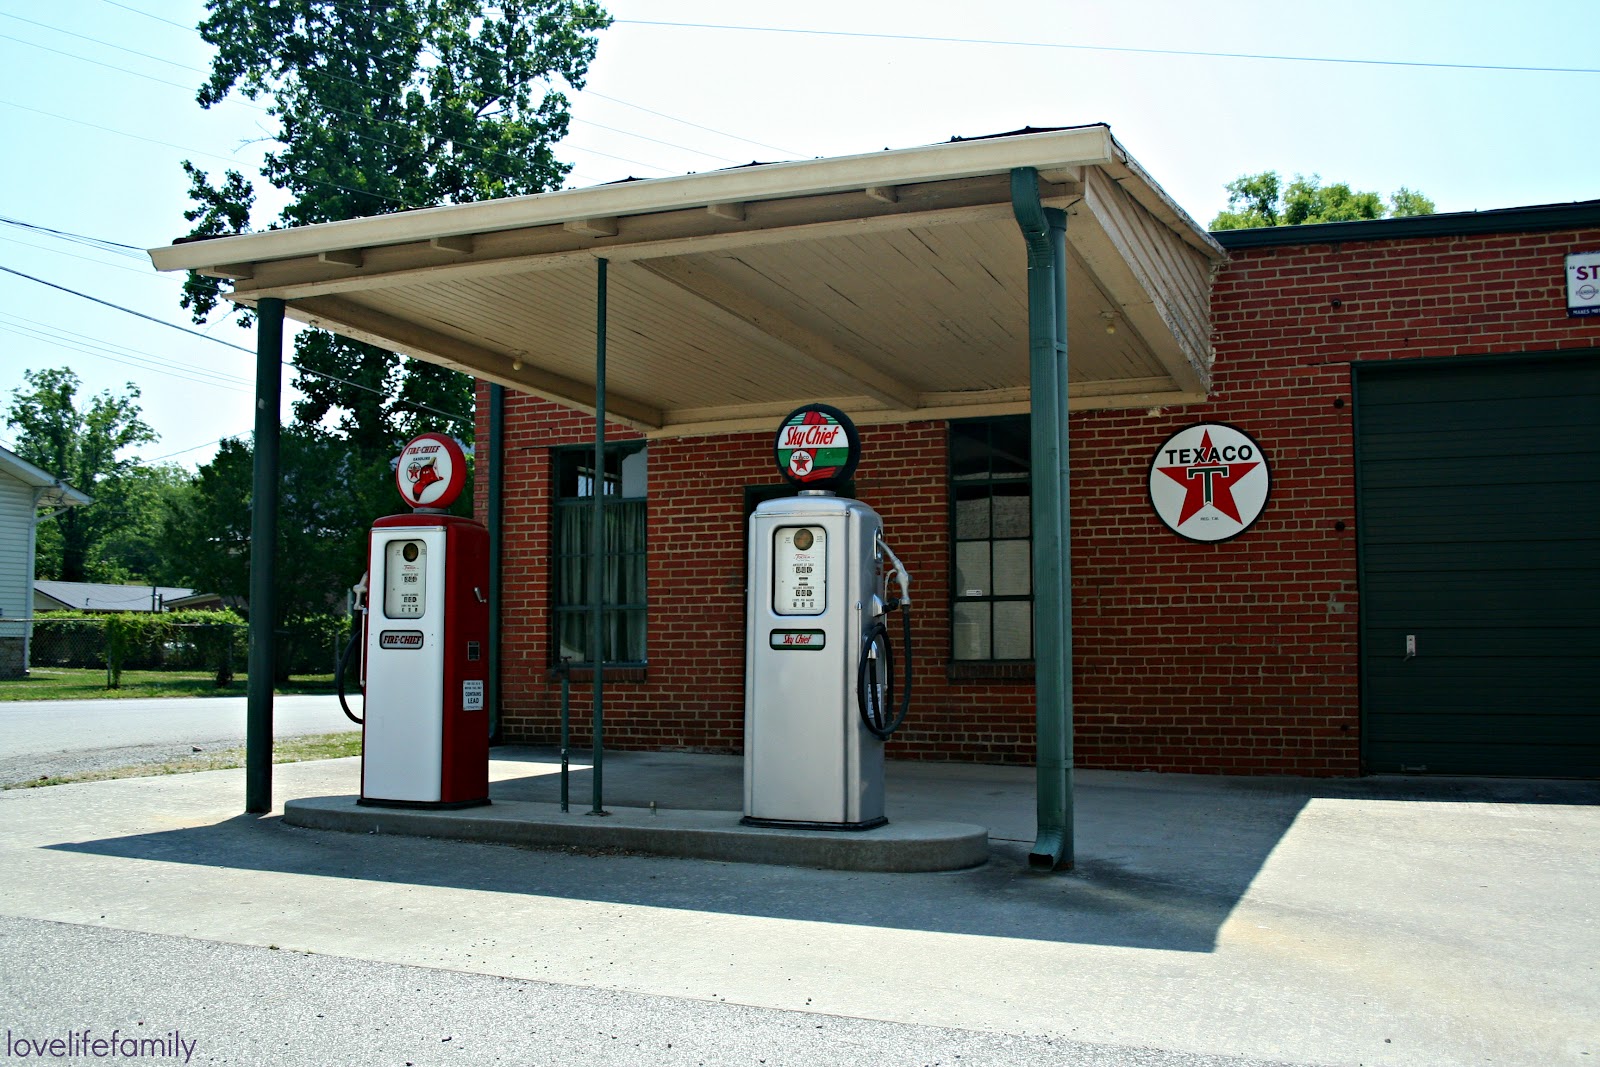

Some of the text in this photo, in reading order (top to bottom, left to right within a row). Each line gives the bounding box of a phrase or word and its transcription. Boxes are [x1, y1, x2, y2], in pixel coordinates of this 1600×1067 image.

[785, 425, 839, 447] Sky Chief
[407, 446, 441, 455] FIRE-CHIEF
[1165, 445, 1253, 464] TEXACO
[1187, 466, 1229, 504] T
[383, 635, 422, 644] FIRE-CHIEF
[783, 634, 812, 645] Sky Chief
